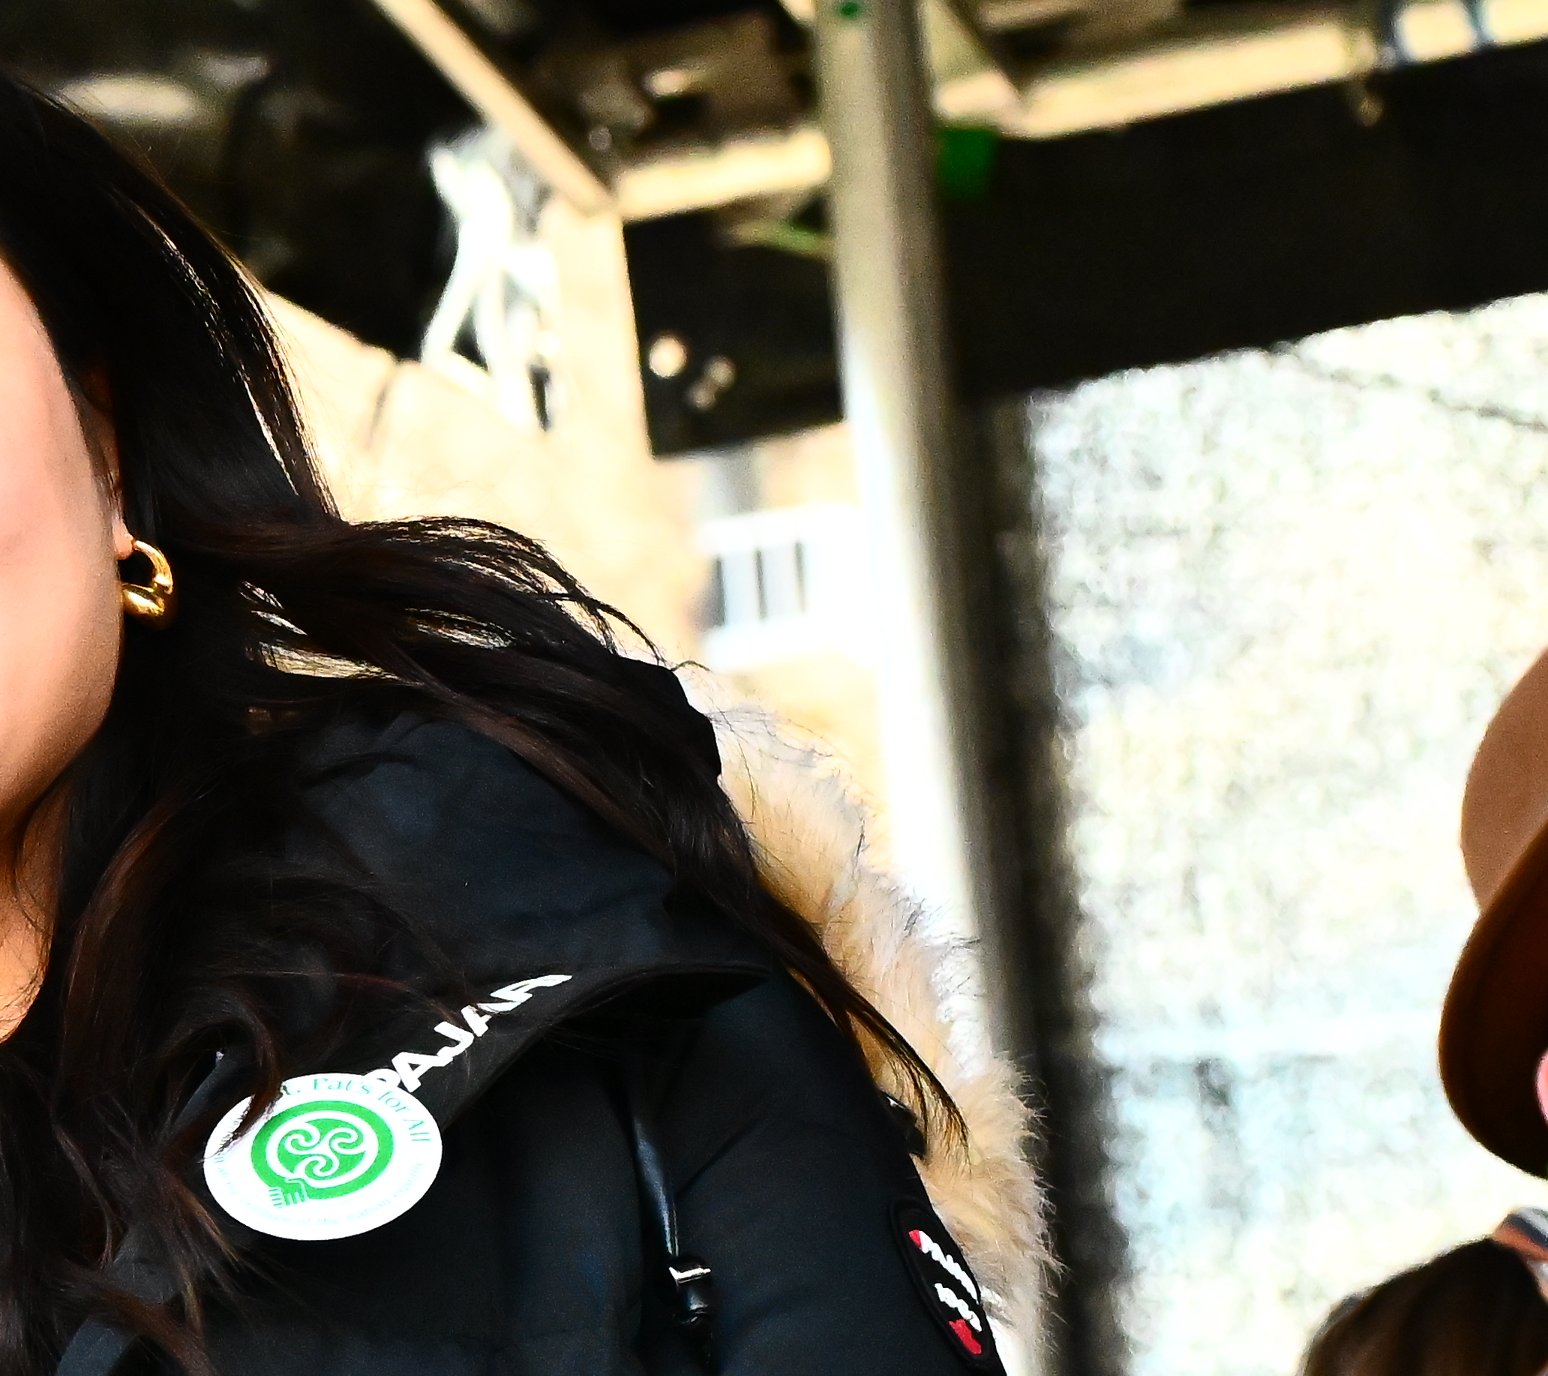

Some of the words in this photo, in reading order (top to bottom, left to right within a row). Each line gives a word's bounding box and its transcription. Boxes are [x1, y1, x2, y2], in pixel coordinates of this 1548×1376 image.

[313, 1077, 373, 1095] Pat's
[376, 1090, 411, 1113] for
[402, 1118, 433, 1142] All
